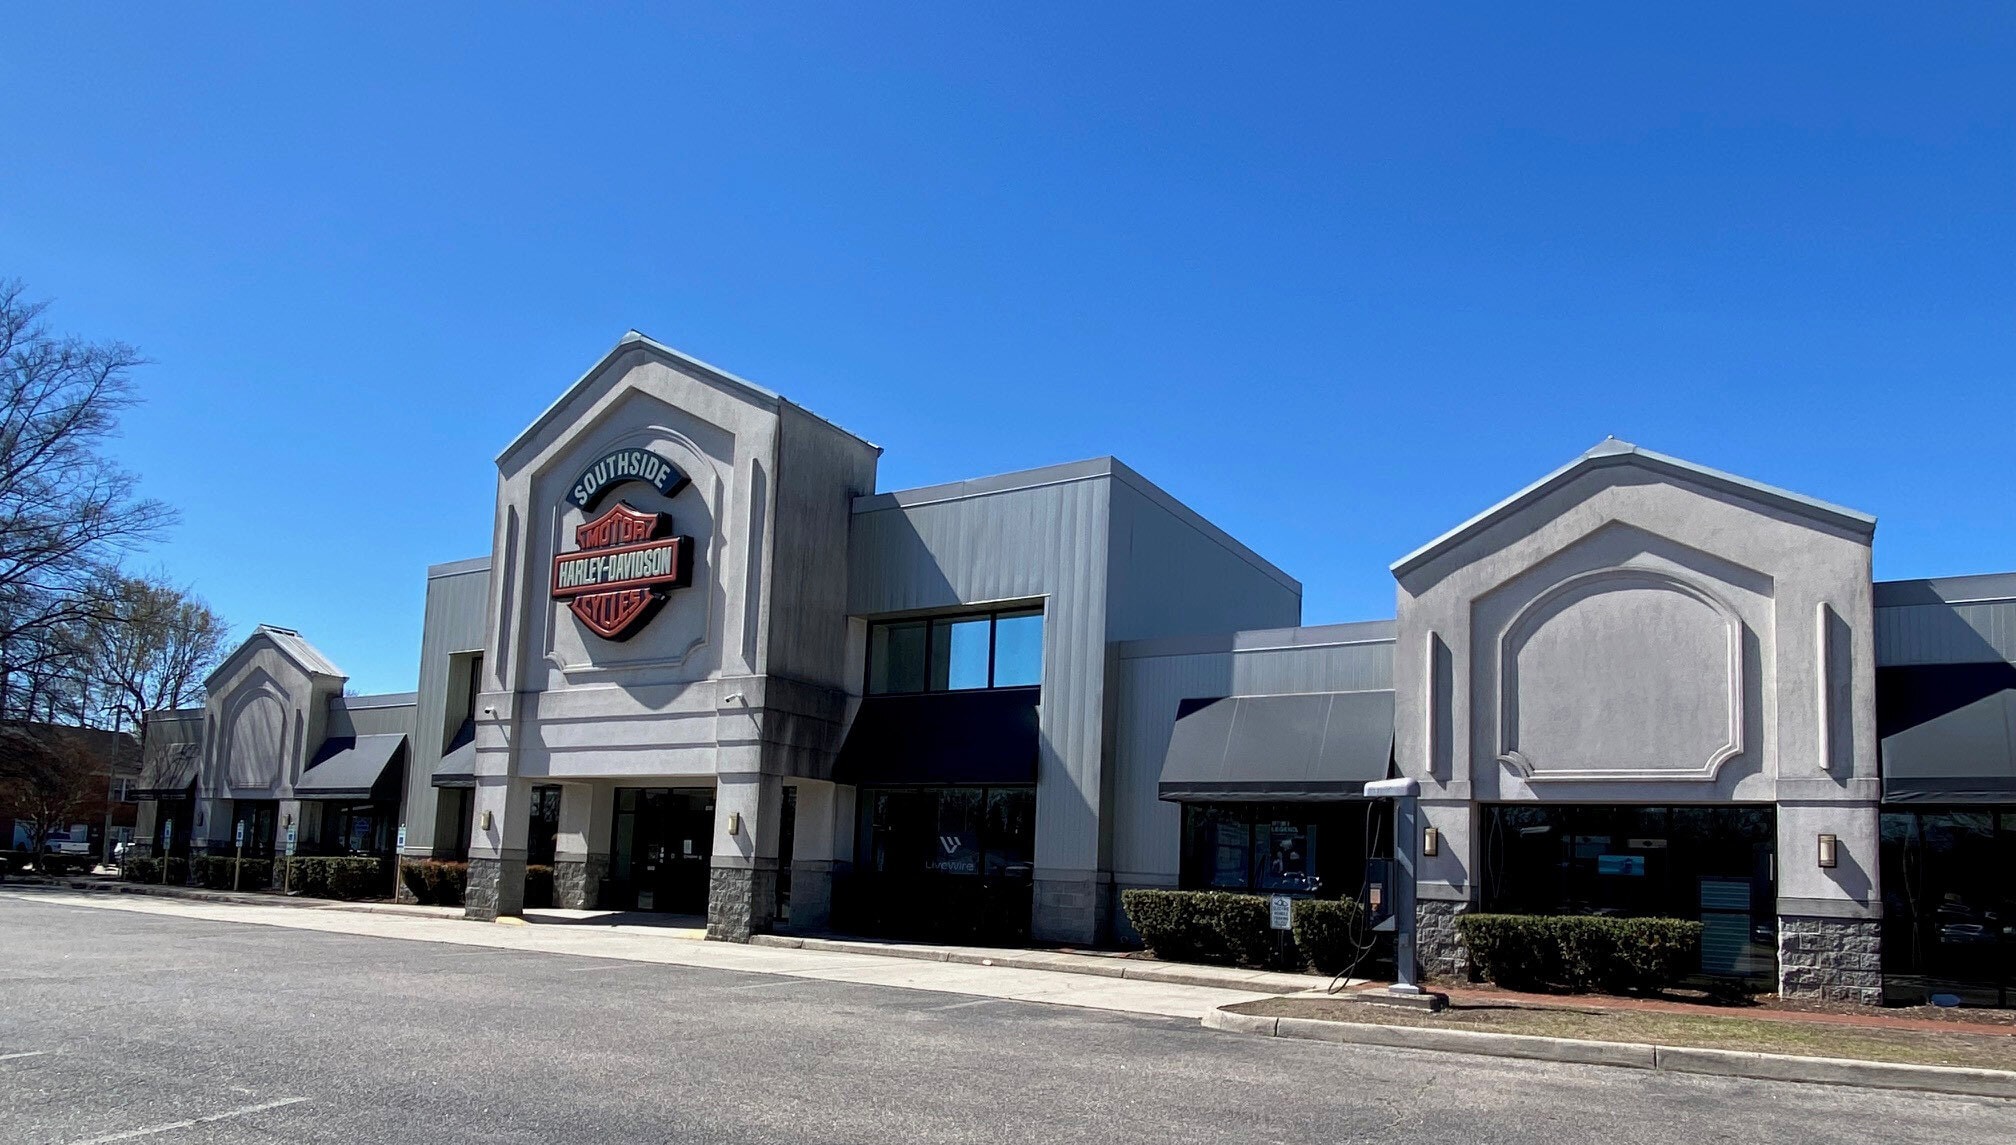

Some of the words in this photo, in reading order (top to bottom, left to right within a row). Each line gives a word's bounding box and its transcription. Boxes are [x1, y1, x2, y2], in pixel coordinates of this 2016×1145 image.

[574, 452, 671, 505] SOUTHSIDE
[588, 513, 645, 547] MOTOR
[558, 547, 672, 587] HARLEY-DAVIDSON
[582, 590, 641, 628] CYCLES
